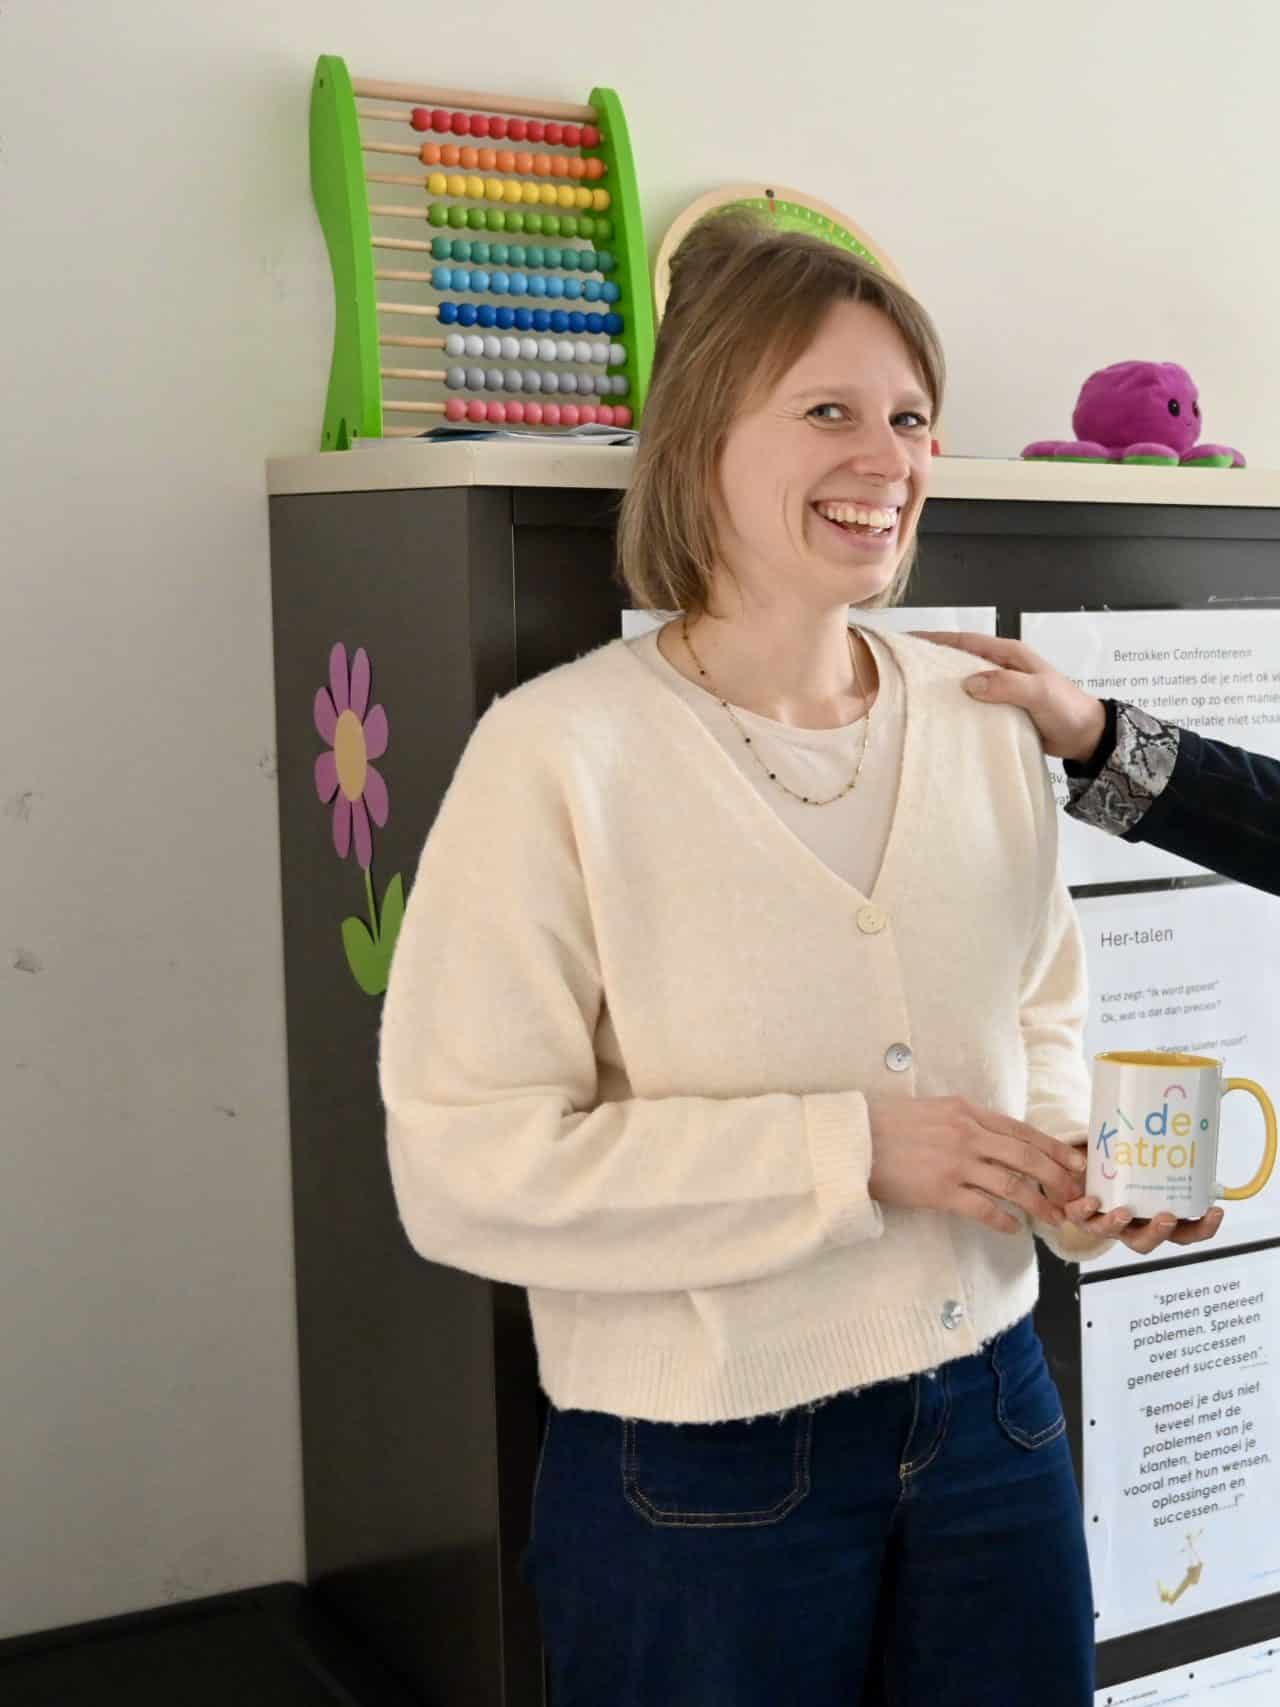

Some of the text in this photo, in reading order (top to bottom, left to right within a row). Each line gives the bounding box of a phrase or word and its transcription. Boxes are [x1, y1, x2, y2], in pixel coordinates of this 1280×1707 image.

[1114, 648, 1170, 662] Betrokken
[1087, 677, 1127, 688] manier
[1130, 676, 1149, 687] om
[1151, 673, 1198, 686] situaties
[1200, 671, 1217, 685] die
[1219, 672, 1230, 687] je
[1232, 671, 1253, 684] niet
[1255, 670, 1269, 683] ok
[1137, 697, 1149, 708] te
[1151, 694, 1189, 707] stellen
[1191, 696, 1205, 709] op
[1207, 695, 1221, 706] zo
[1223, 695, 1244, 705] een
[1227, 713, 1248, 726] niet
[1100, 927, 1173, 948] Her-talen
[1145, 1103, 1192, 1136] de
[1213, 1280, 1241, 1295] over
[1129, 1291, 1264, 1333] problemen genereert
[1210, 1311, 1261, 1332] Spreken
[1149, 1333, 1246, 1364] over successen
[1127, 1363, 1190, 1390] genereert
[1196, 1393, 1209, 1410] je
[1212, 1388, 1234, 1402] dus
[1237, 1381, 1260, 1397] niet
[1155, 1405, 1241, 1435] teveel met de
[1142, 1419, 1254, 1458] problemen van je
[1194, 1442, 1242, 1462] bemoei
[1244, 1437, 1256, 1453] je
[1123, 1477, 1164, 1497] vooral
[1167, 1472, 1192, 1487] met
[1195, 1465, 1218, 1480] hun
[1151, 1476, 1245, 1509] oplossingen en
